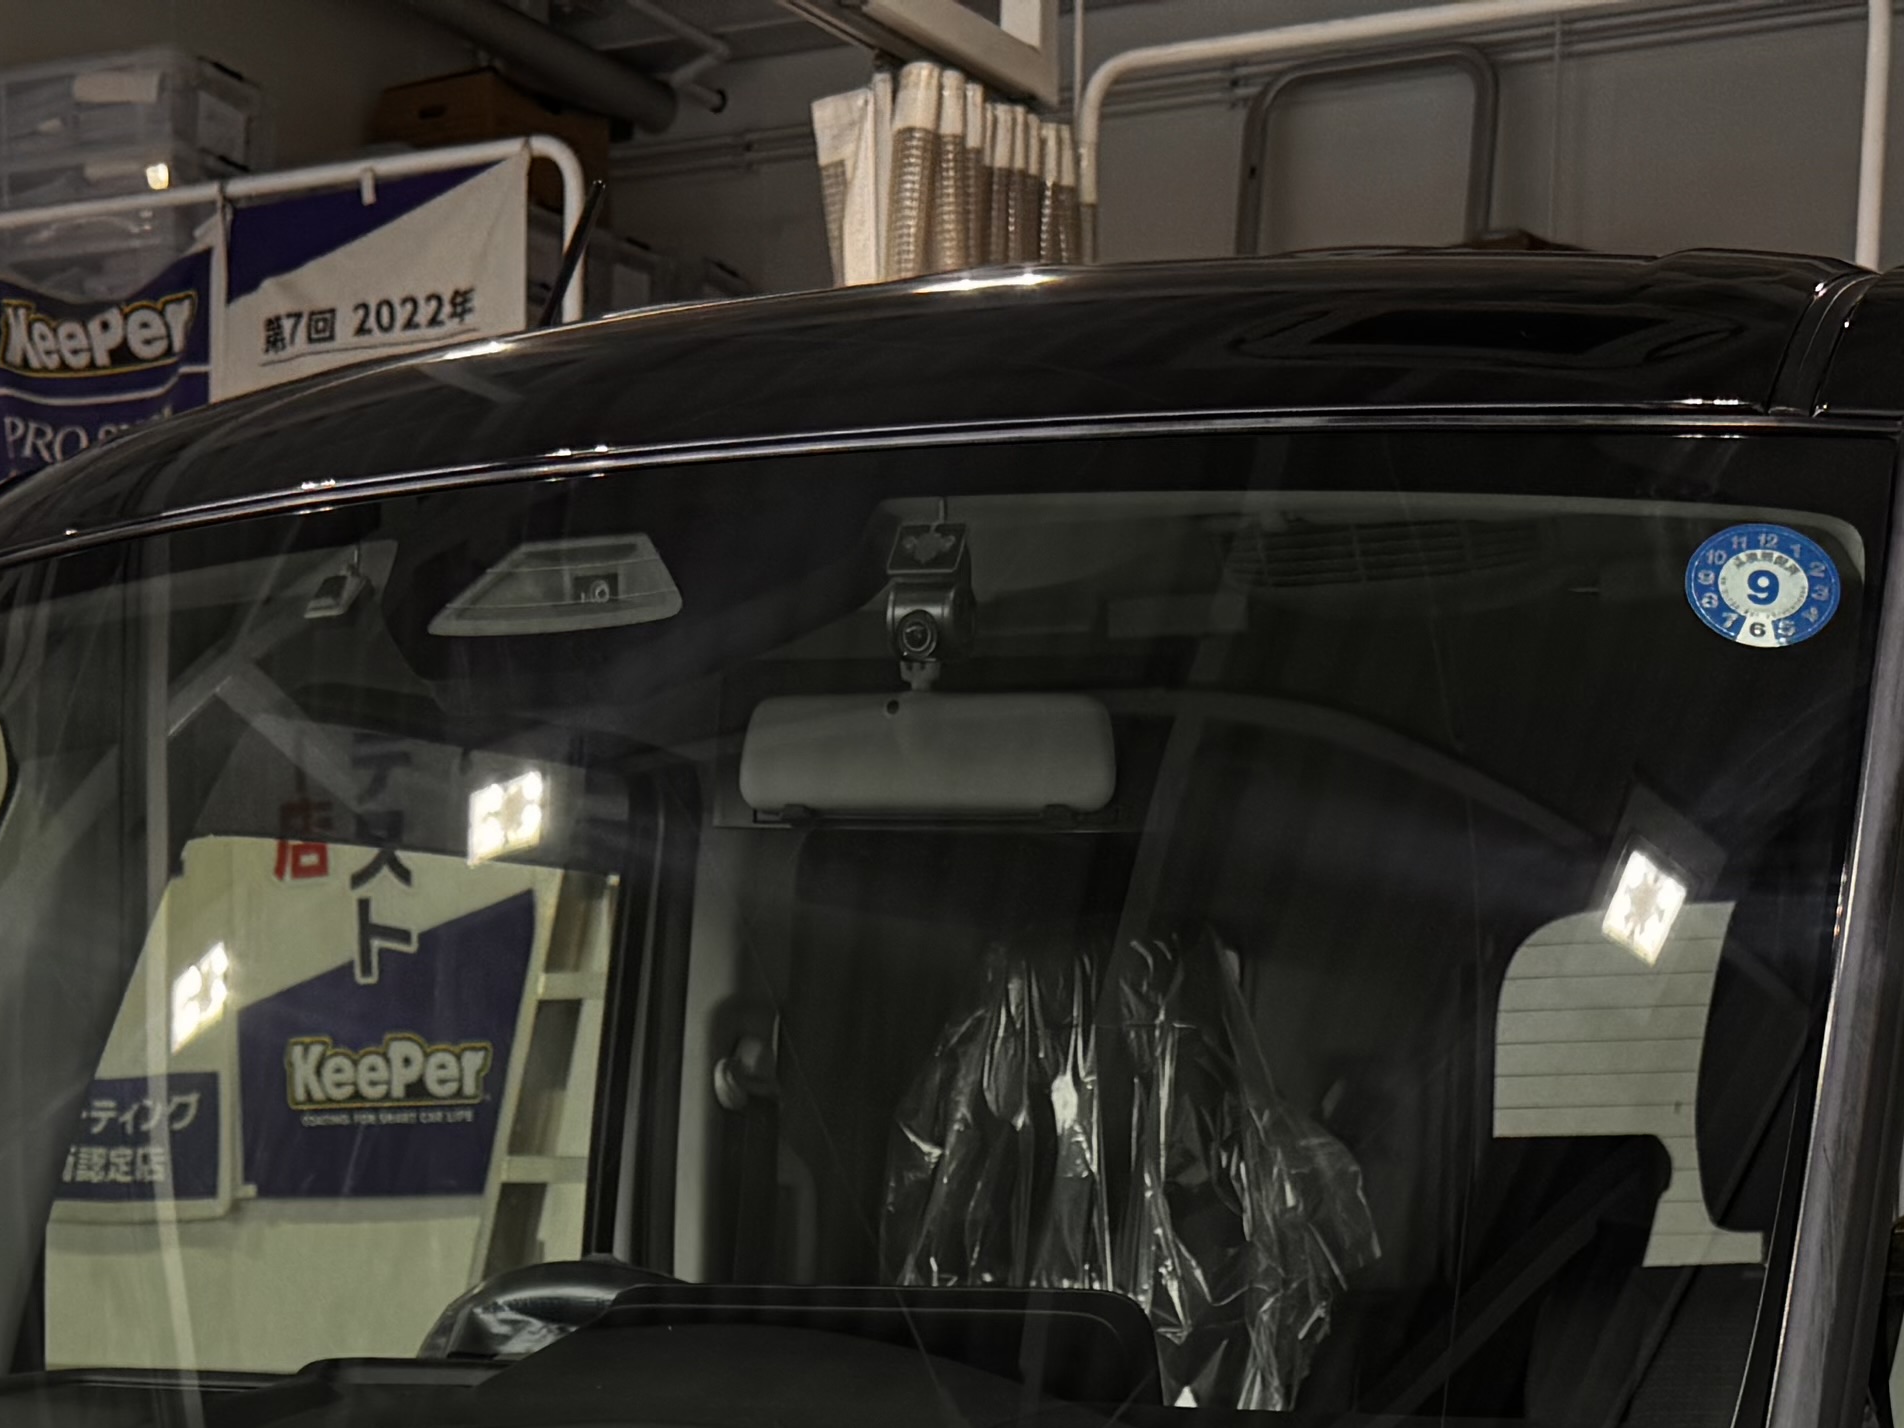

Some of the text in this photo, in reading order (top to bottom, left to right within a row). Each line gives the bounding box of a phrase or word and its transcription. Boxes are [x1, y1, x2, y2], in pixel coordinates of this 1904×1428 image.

[264, 287, 475, 355] 第7回 2022年
[1747, 569, 1780, 606] 9
[1749, 622, 1766, 638] 6
[285, 1033, 494, 1108] KeePer
[80, 1091, 201, 1135] ティング
